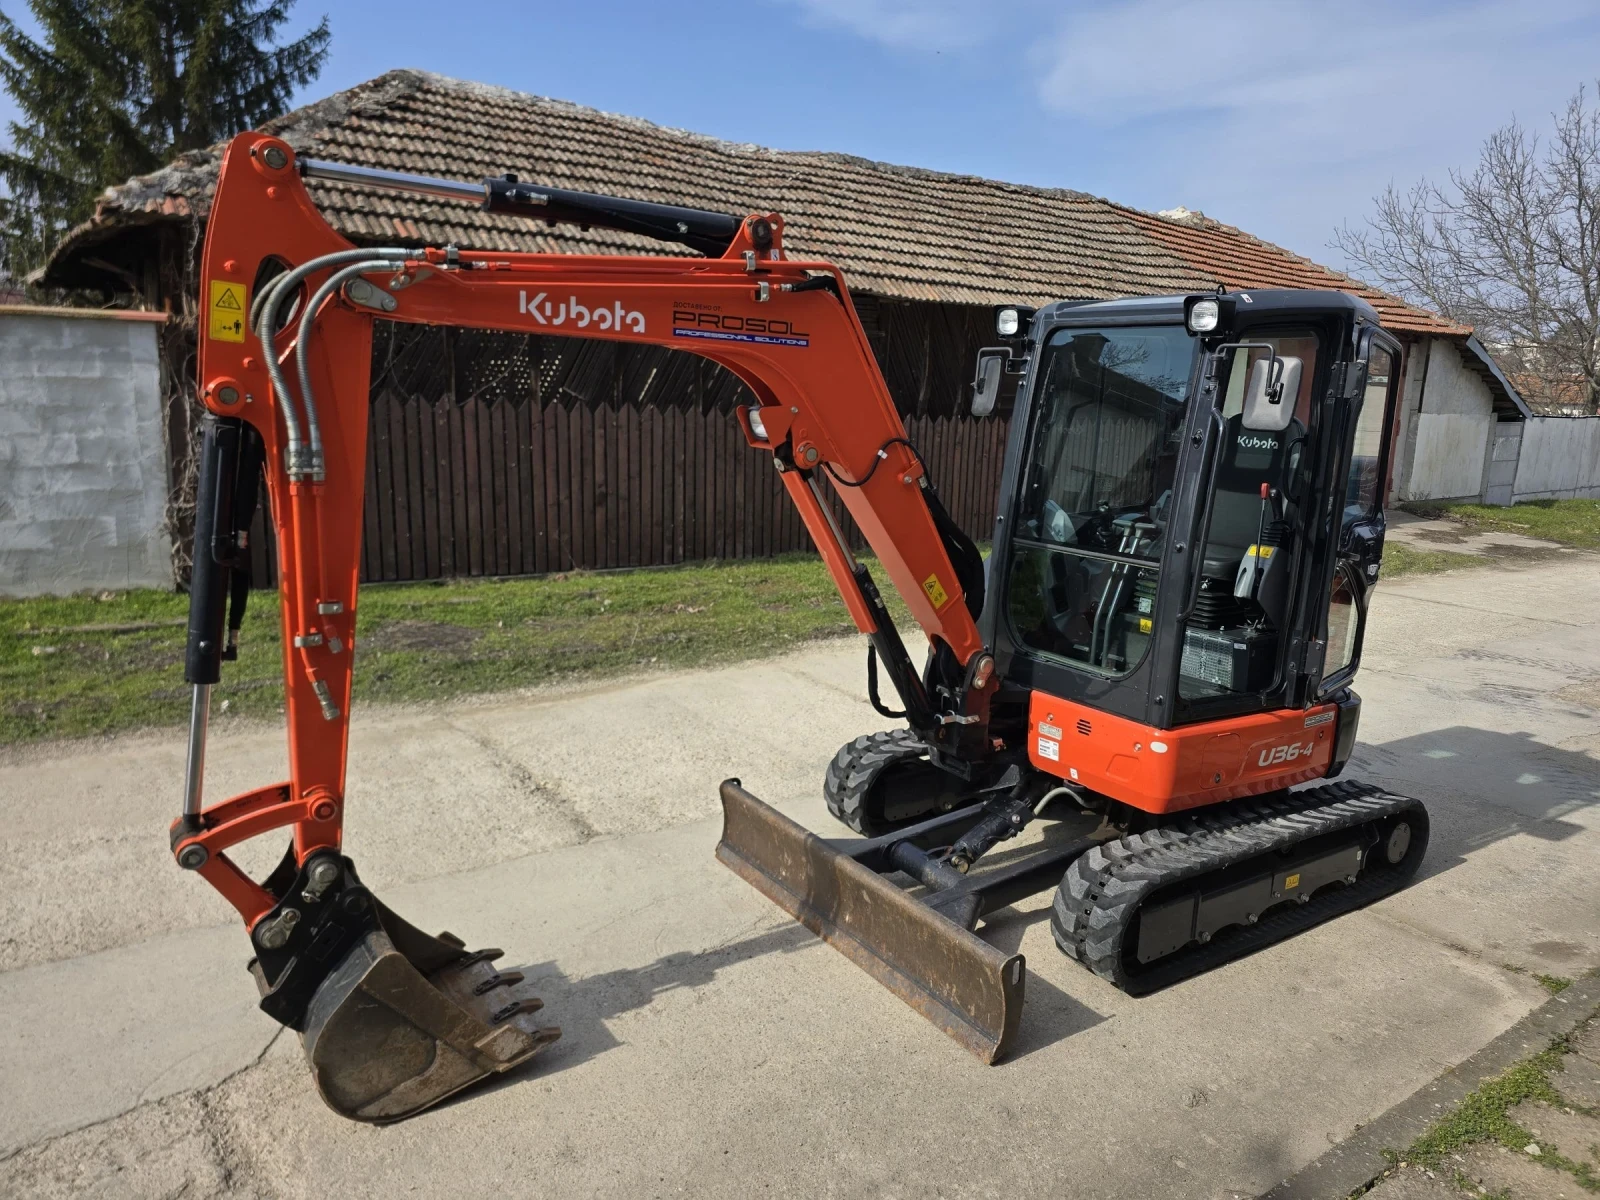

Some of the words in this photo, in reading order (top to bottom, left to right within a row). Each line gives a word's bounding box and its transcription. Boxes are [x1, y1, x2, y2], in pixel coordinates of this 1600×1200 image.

[519, 290, 646, 333] Kubota
[672, 310, 810, 337] PROSOL
[675, 329, 752, 341] PROFESSIONAL
[754, 336, 807, 346] SOLUTIONS
[1237, 435, 1279, 449] Kubota
[1258, 742, 1314, 767] U36-4
